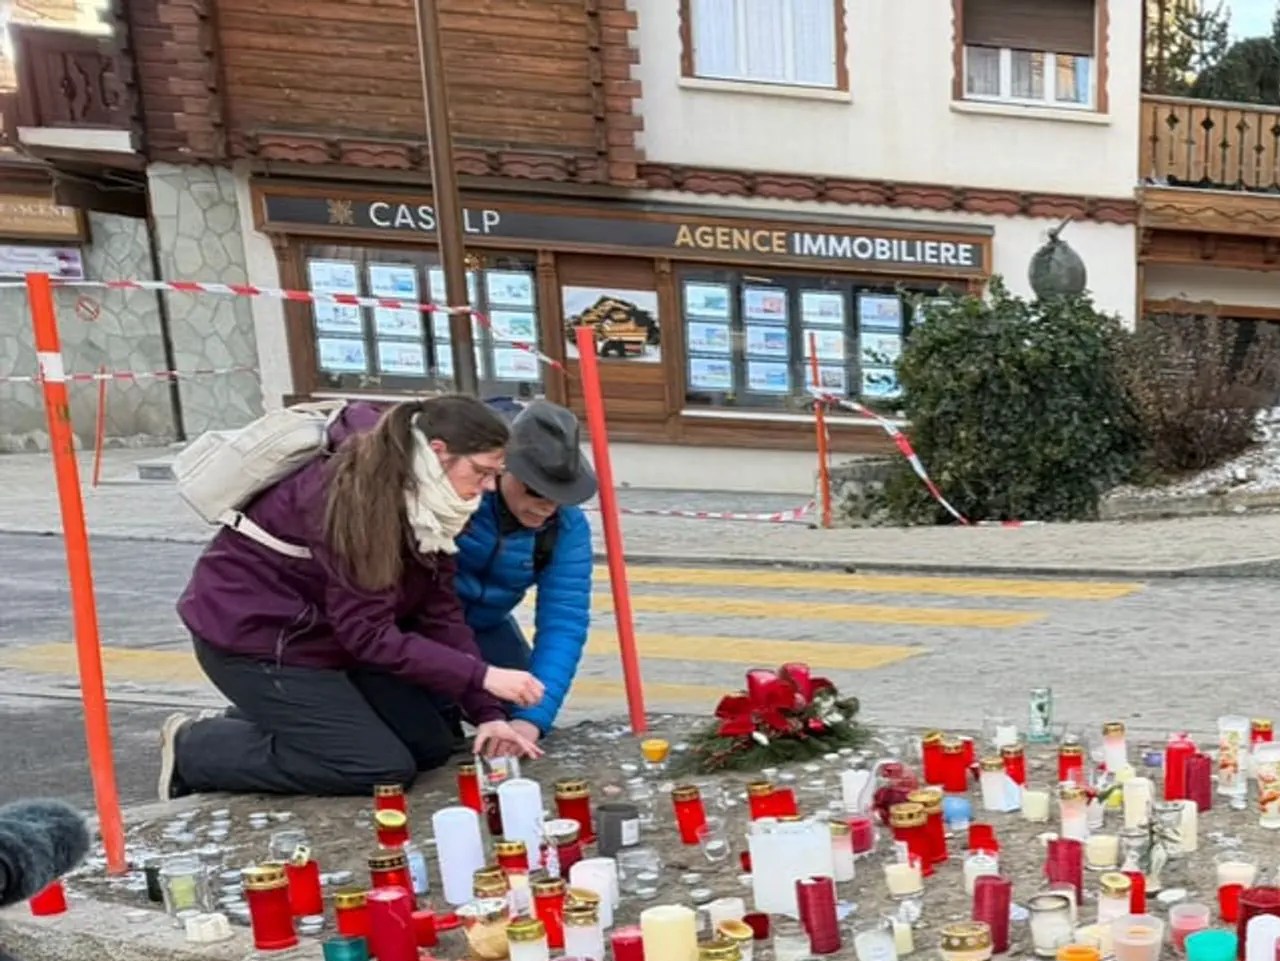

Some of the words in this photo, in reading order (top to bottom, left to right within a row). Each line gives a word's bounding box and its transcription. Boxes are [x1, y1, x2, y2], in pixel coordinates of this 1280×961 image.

[369, 202, 500, 234] CASLP
[674, 224, 787, 253] AGENCE
[793, 232, 973, 266] IMMOBILIERE
